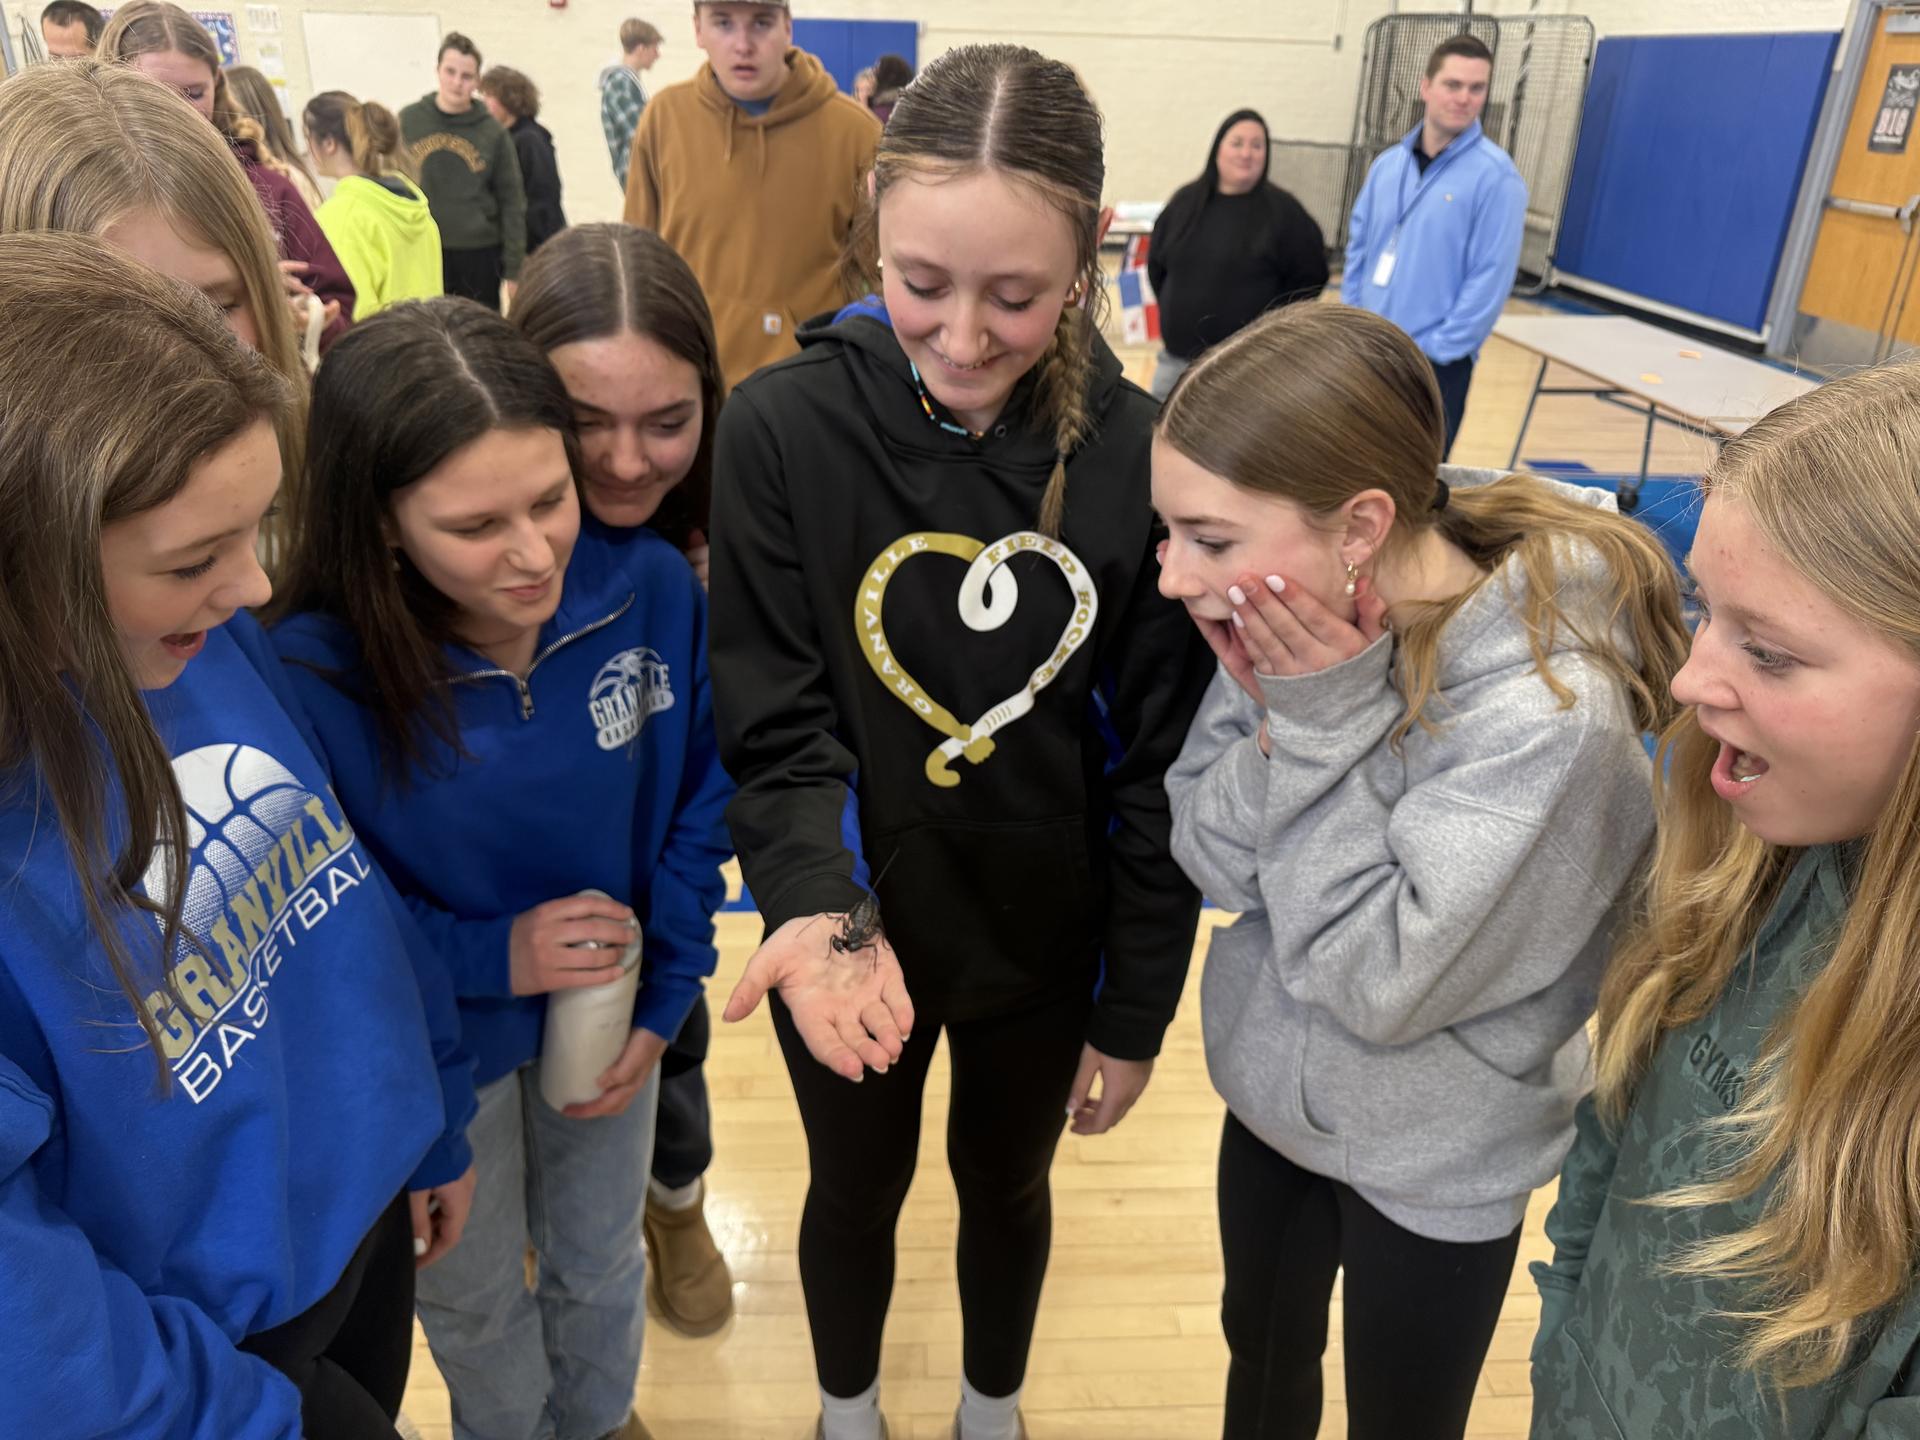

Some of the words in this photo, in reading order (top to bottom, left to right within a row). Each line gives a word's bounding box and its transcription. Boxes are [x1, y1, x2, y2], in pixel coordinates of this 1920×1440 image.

[863, 536, 933, 715] GRANVILLE
[985, 535, 1078, 576] FIELD
[144, 788, 354, 1059] GRANVILL
